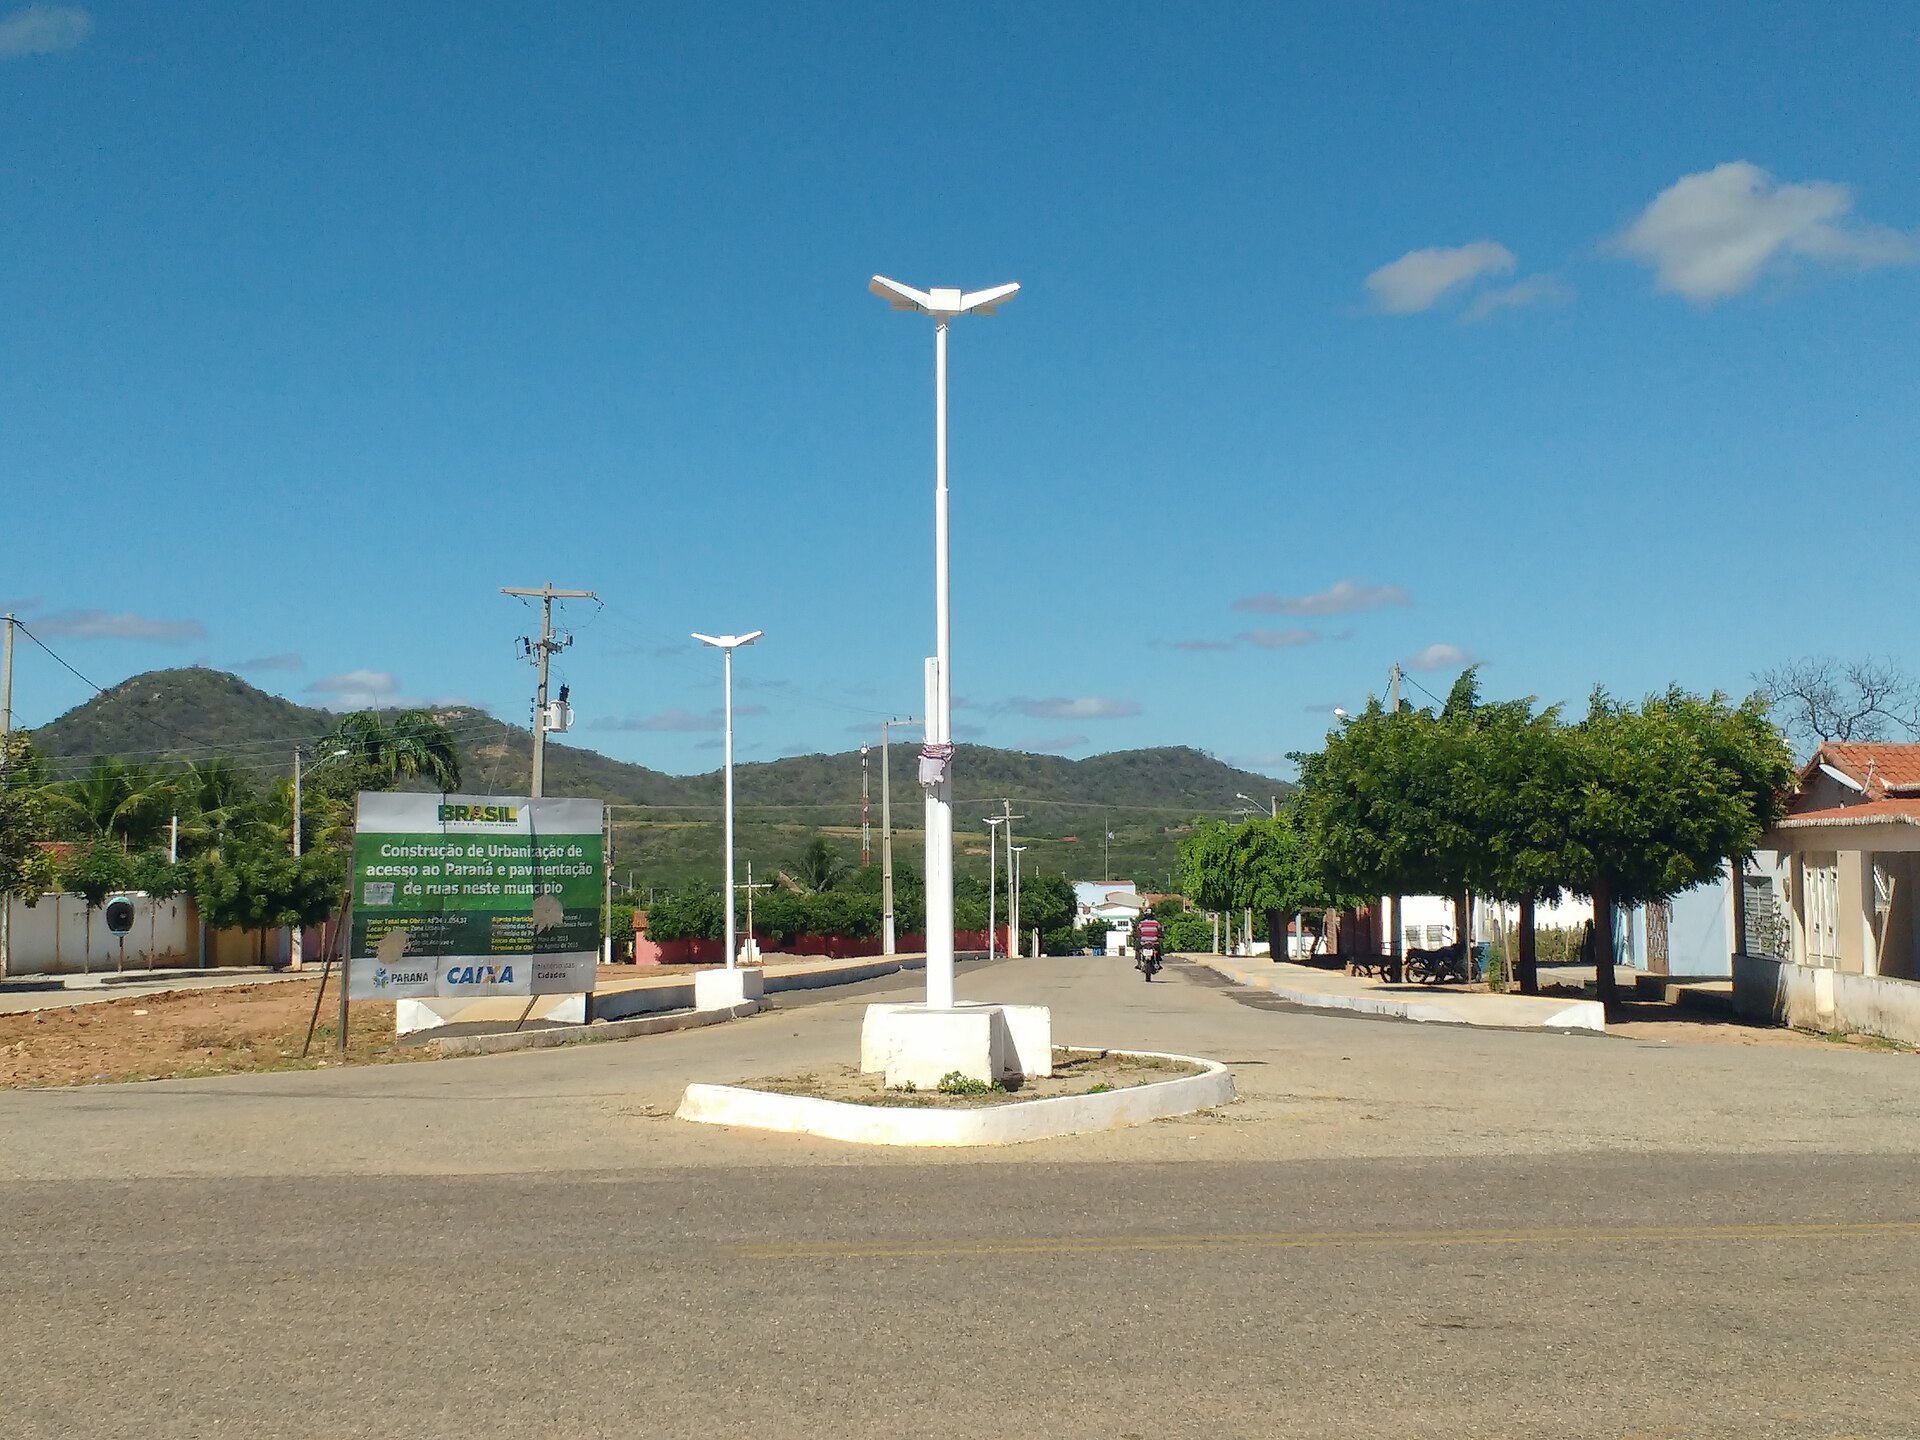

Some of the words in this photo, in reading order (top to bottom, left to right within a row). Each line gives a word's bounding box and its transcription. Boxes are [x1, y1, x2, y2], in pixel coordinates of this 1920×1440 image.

[438, 804, 518, 823] BRASIL
[381, 843, 464, 860] Construção
[467, 843, 484, 857] de
[567, 844, 583, 857] de
[366, 865, 418, 876] acesso
[422, 865, 440, 876] ao
[445, 862, 494, 876] Paraná
[497, 865, 506, 875] e
[403, 880, 422, 895] de
[426, 884, 460, 895] ruas
[462, 882, 501, 895] neste
[447, 965, 514, 985] CAIXA
[537, 971, 566, 979] Cidades
